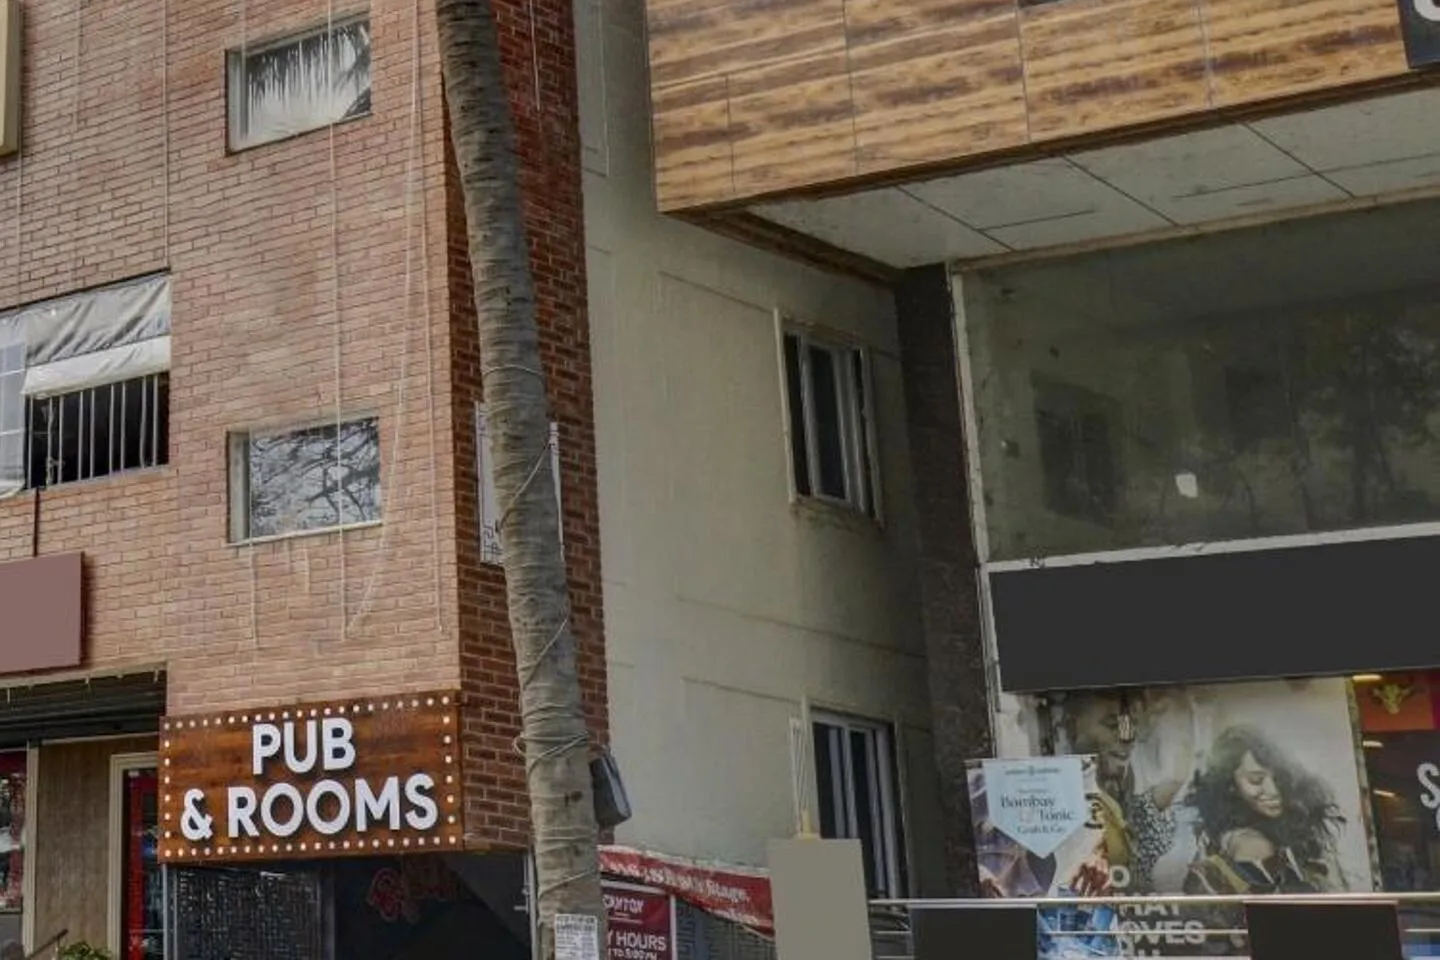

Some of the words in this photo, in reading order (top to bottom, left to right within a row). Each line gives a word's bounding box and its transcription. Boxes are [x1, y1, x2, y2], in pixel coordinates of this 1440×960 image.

[253, 717, 356, 775] PUB
[180, 788, 213, 840] &
[227, 773, 438, 838] ROOMS
[616, 929, 667, 951] HOURS
